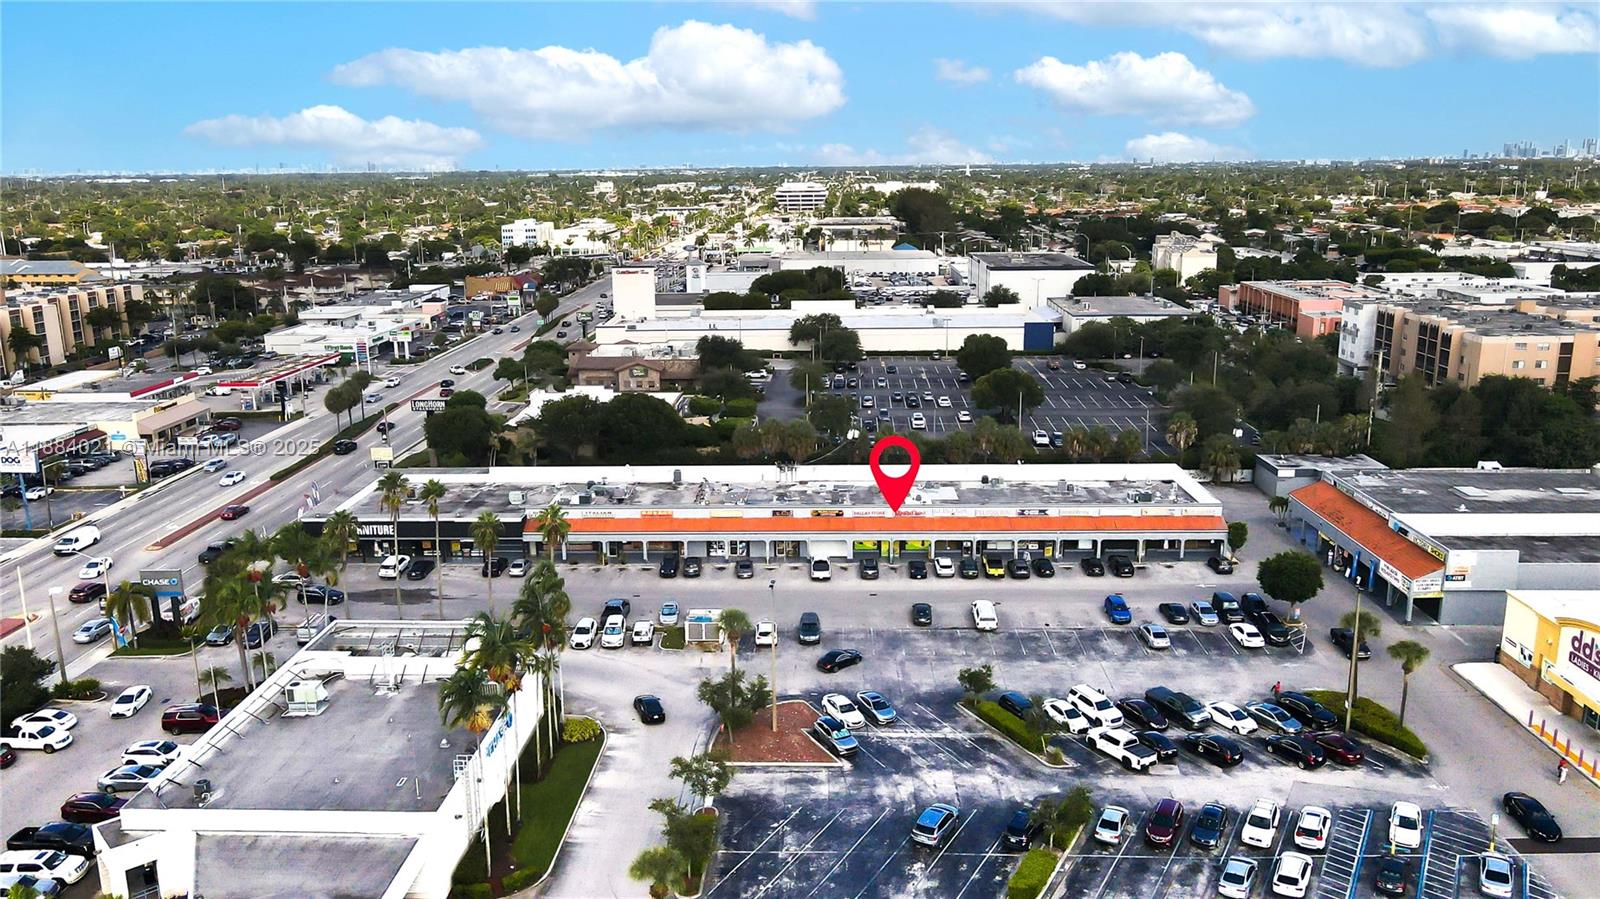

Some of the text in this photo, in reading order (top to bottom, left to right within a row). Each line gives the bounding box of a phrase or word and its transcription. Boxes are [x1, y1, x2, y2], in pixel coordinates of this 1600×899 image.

[411, 400, 445, 408] LONGHORN
[1, 456, 21, 464] DOG
[356, 524, 395, 536] RNITURE
[1570, 654, 1589, 672] LADIES
